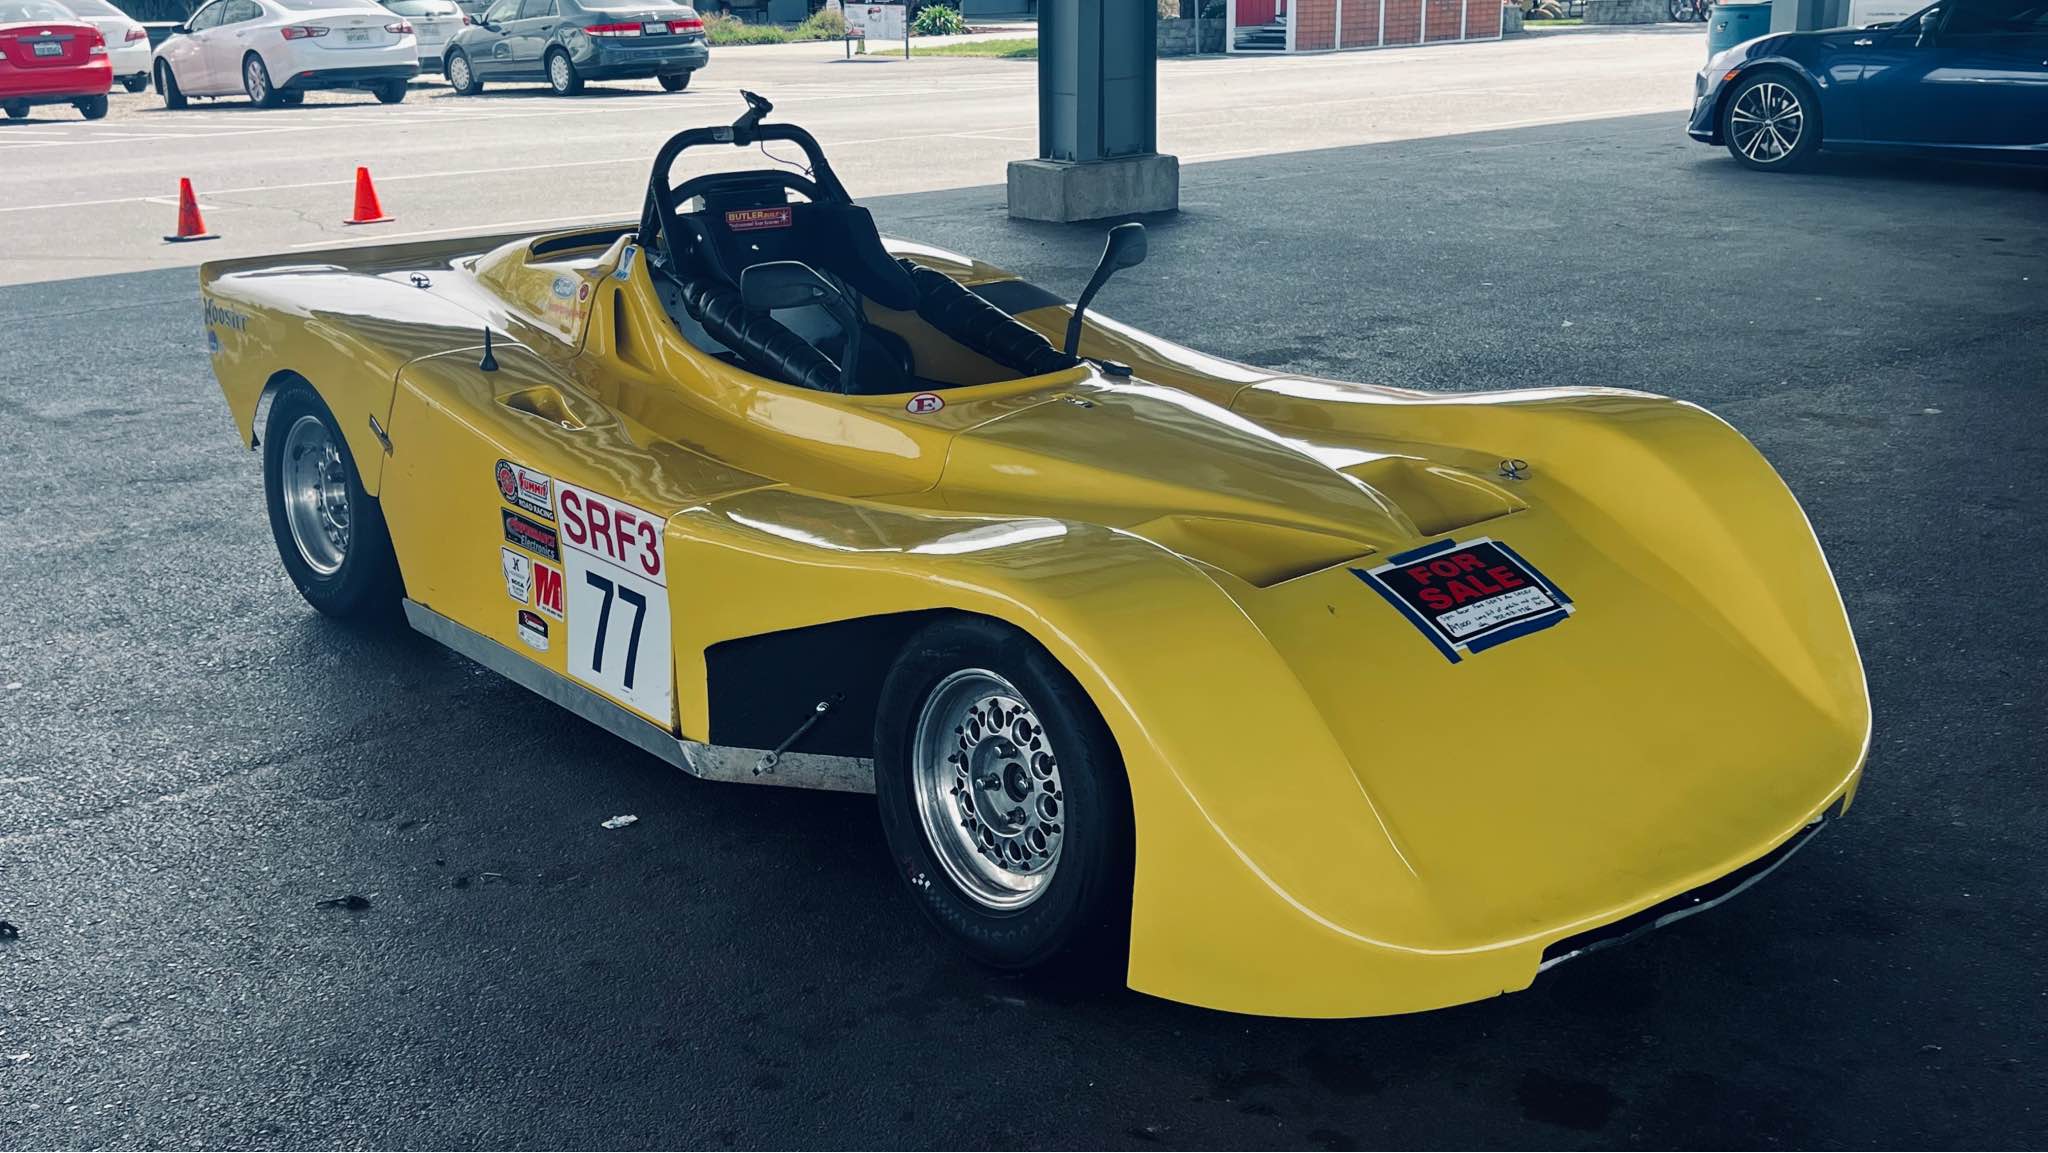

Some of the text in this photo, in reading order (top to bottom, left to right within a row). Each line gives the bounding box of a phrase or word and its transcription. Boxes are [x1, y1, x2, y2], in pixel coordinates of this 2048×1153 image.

[914, 397, 936, 413] E
[561, 489, 660, 576] SRF3
[1409, 553, 1487, 584] FOR
[1418, 566, 1525, 610] SALE
[585, 569, 647, 690] 77
